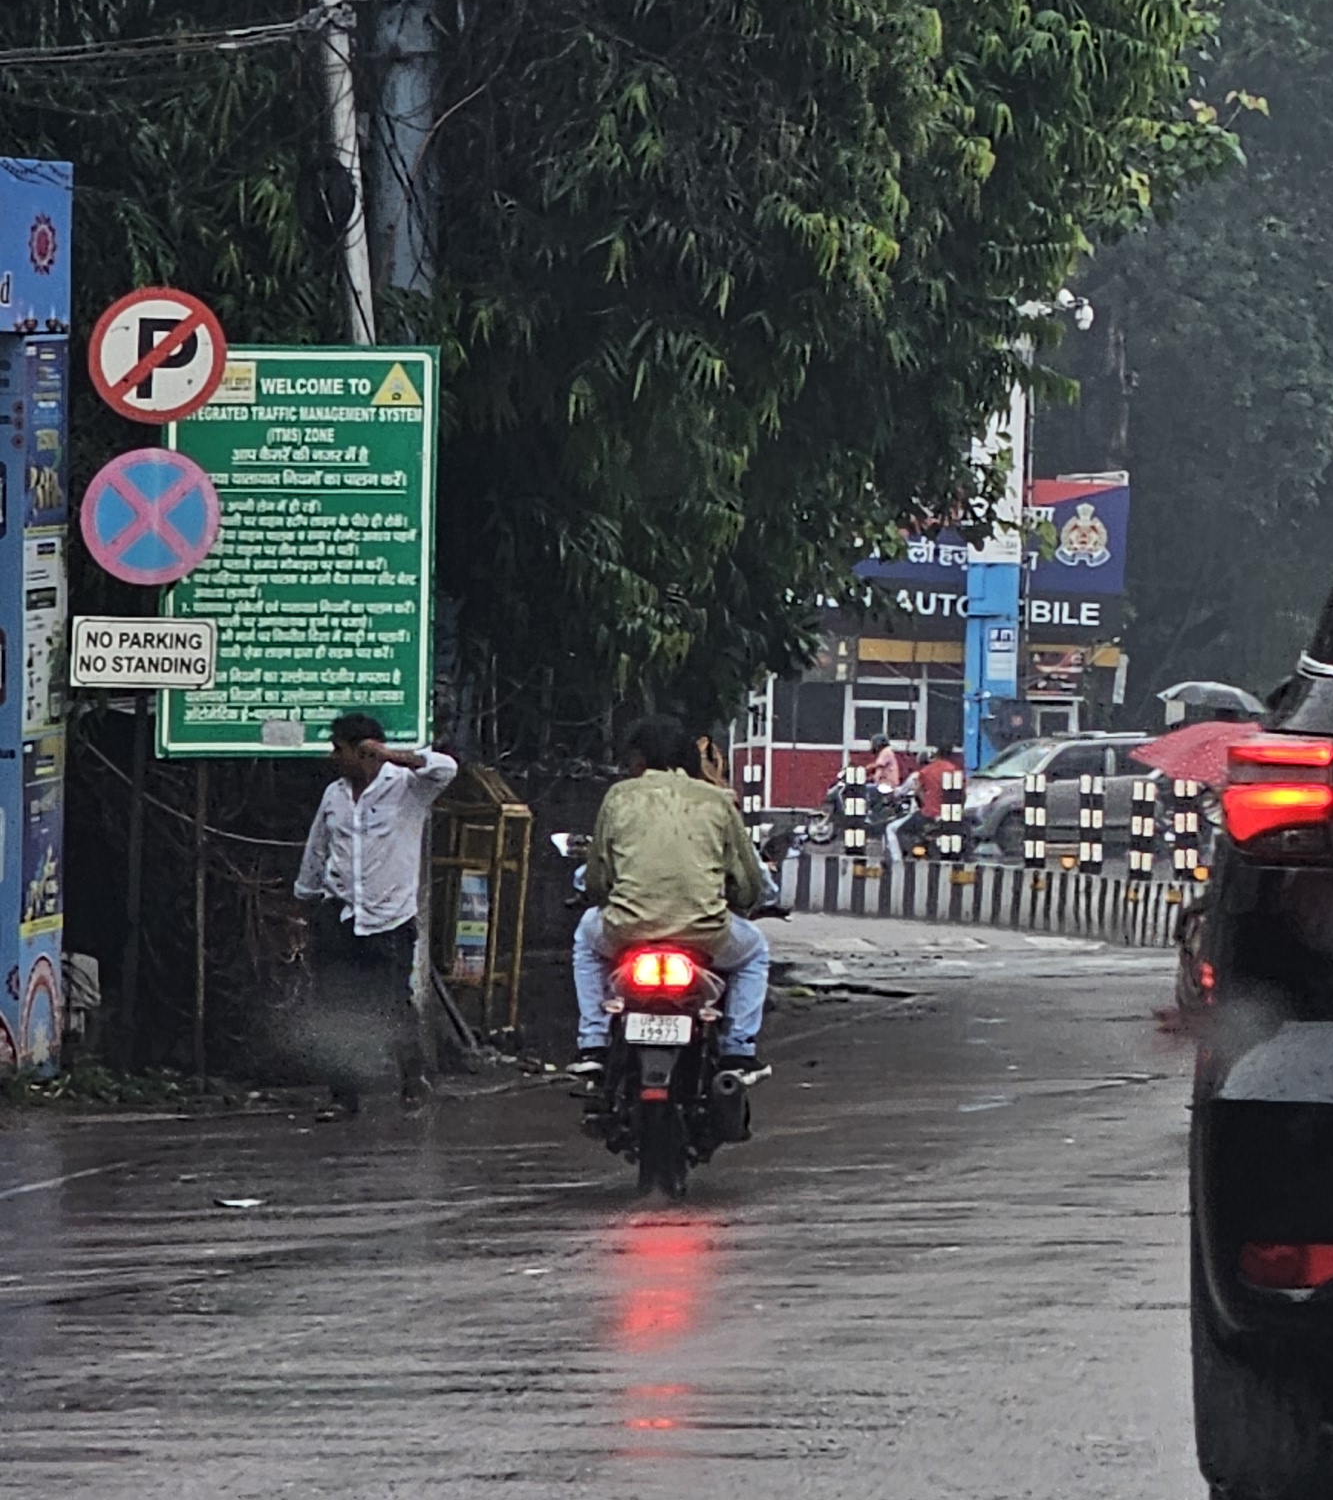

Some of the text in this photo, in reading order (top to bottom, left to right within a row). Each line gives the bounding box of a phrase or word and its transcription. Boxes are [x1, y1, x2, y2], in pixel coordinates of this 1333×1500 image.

[260, 377, 344, 395] WELCOME
[348, 377, 371, 395] TO
[251, 406, 298, 422] TRAFFIC
[300, 406, 376, 423] MANAGEMENT
[378, 407, 423, 423] SYSTEM
[304, 427, 335, 442] ZONE
[85, 631, 113, 649] NO
[117, 631, 203, 650] PARKING
[79, 655, 207, 674] NO STANDING
